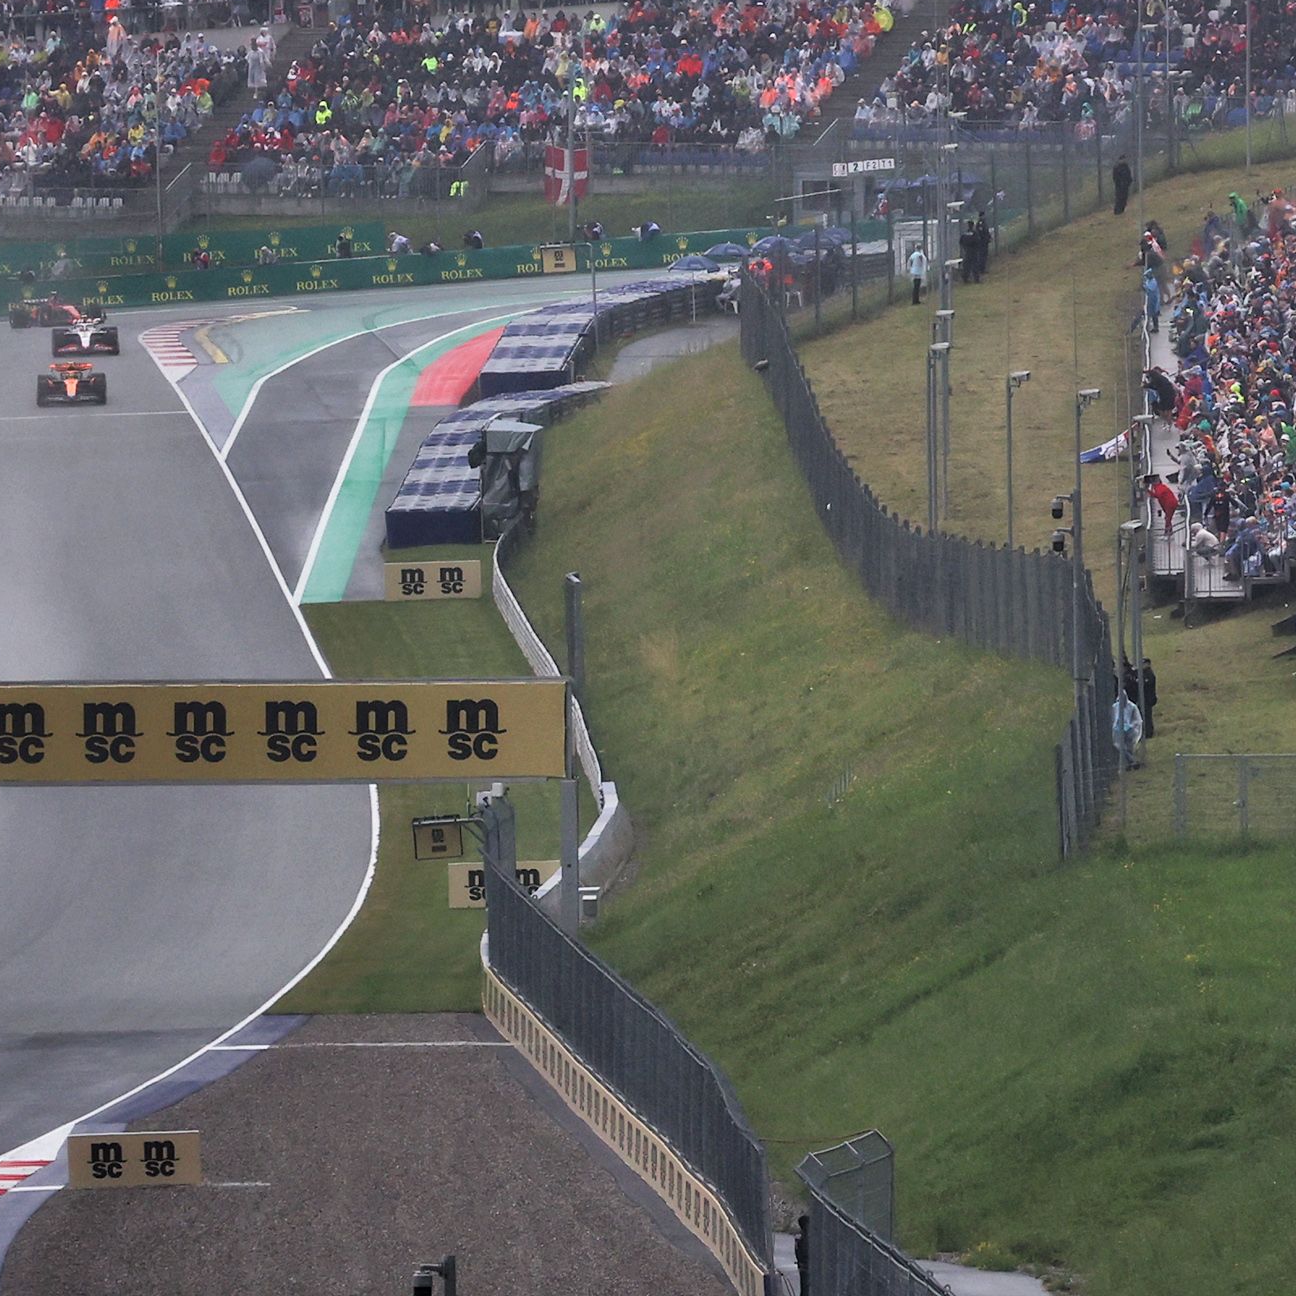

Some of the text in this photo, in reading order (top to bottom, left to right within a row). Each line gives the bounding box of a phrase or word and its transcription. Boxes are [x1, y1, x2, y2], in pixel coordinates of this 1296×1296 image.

[328, 242, 371, 253] REX
[111, 255, 154, 266] ROLEX
[184, 251, 225, 262] REX
[372, 272, 414, 284] ROLEX
[441, 268, 483, 280] ROLEX
[228, 285, 269, 296] ROLEX
[296, 279, 339, 291] ROLEX
[152, 291, 193, 302] ROLEX
